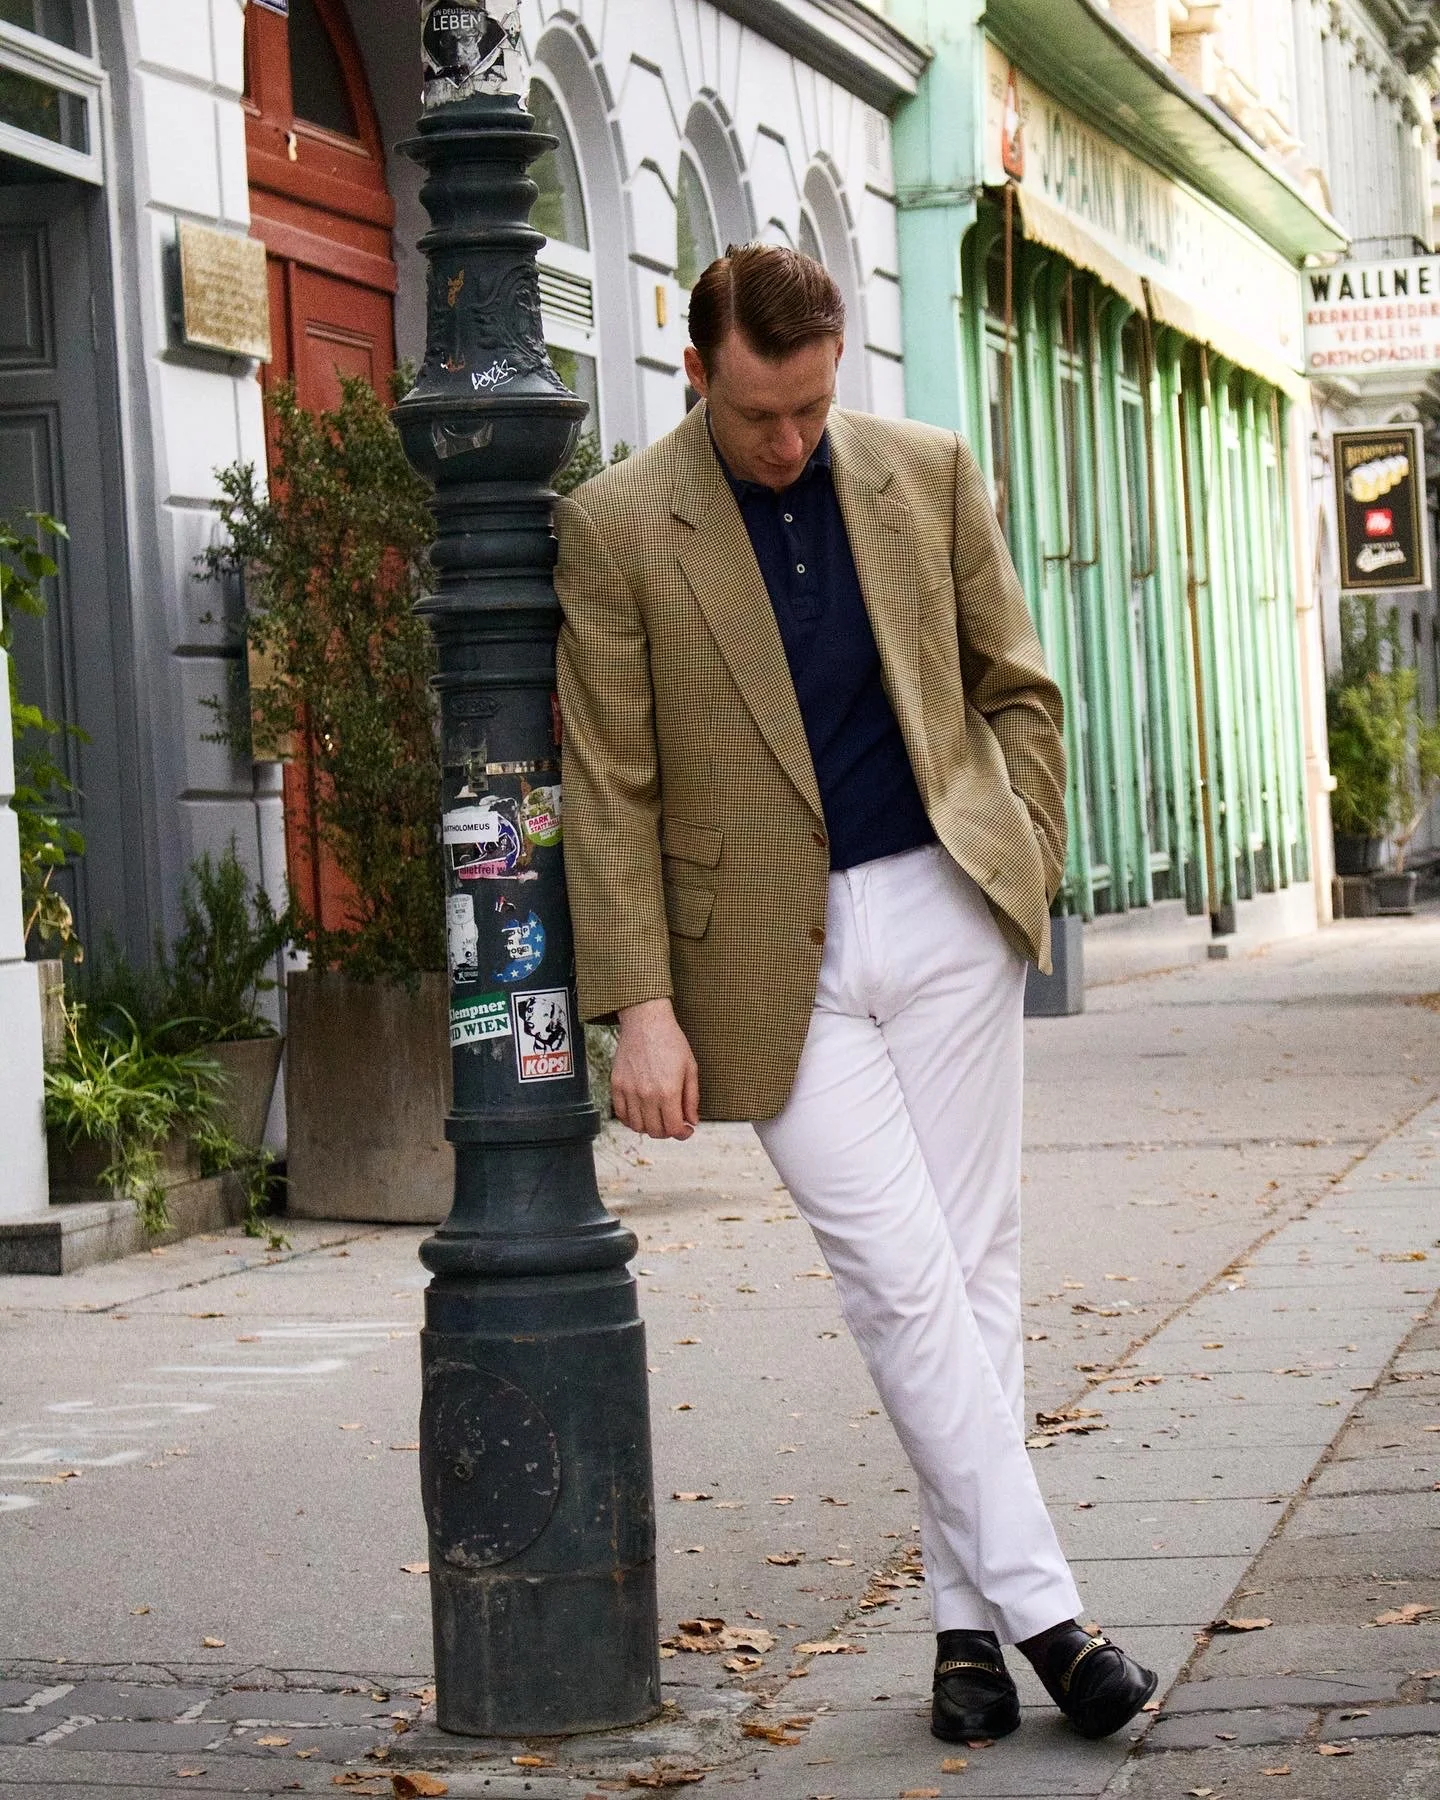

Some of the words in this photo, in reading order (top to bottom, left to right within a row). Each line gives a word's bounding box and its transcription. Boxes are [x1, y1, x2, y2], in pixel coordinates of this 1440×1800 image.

[433, 14, 481, 31] LEBEN
[1310, 267, 1440, 302] WALLNE
[528, 815, 549, 827] PARK
[531, 822, 547, 833] STATT
[464, 1017, 508, 1037] WIEN
